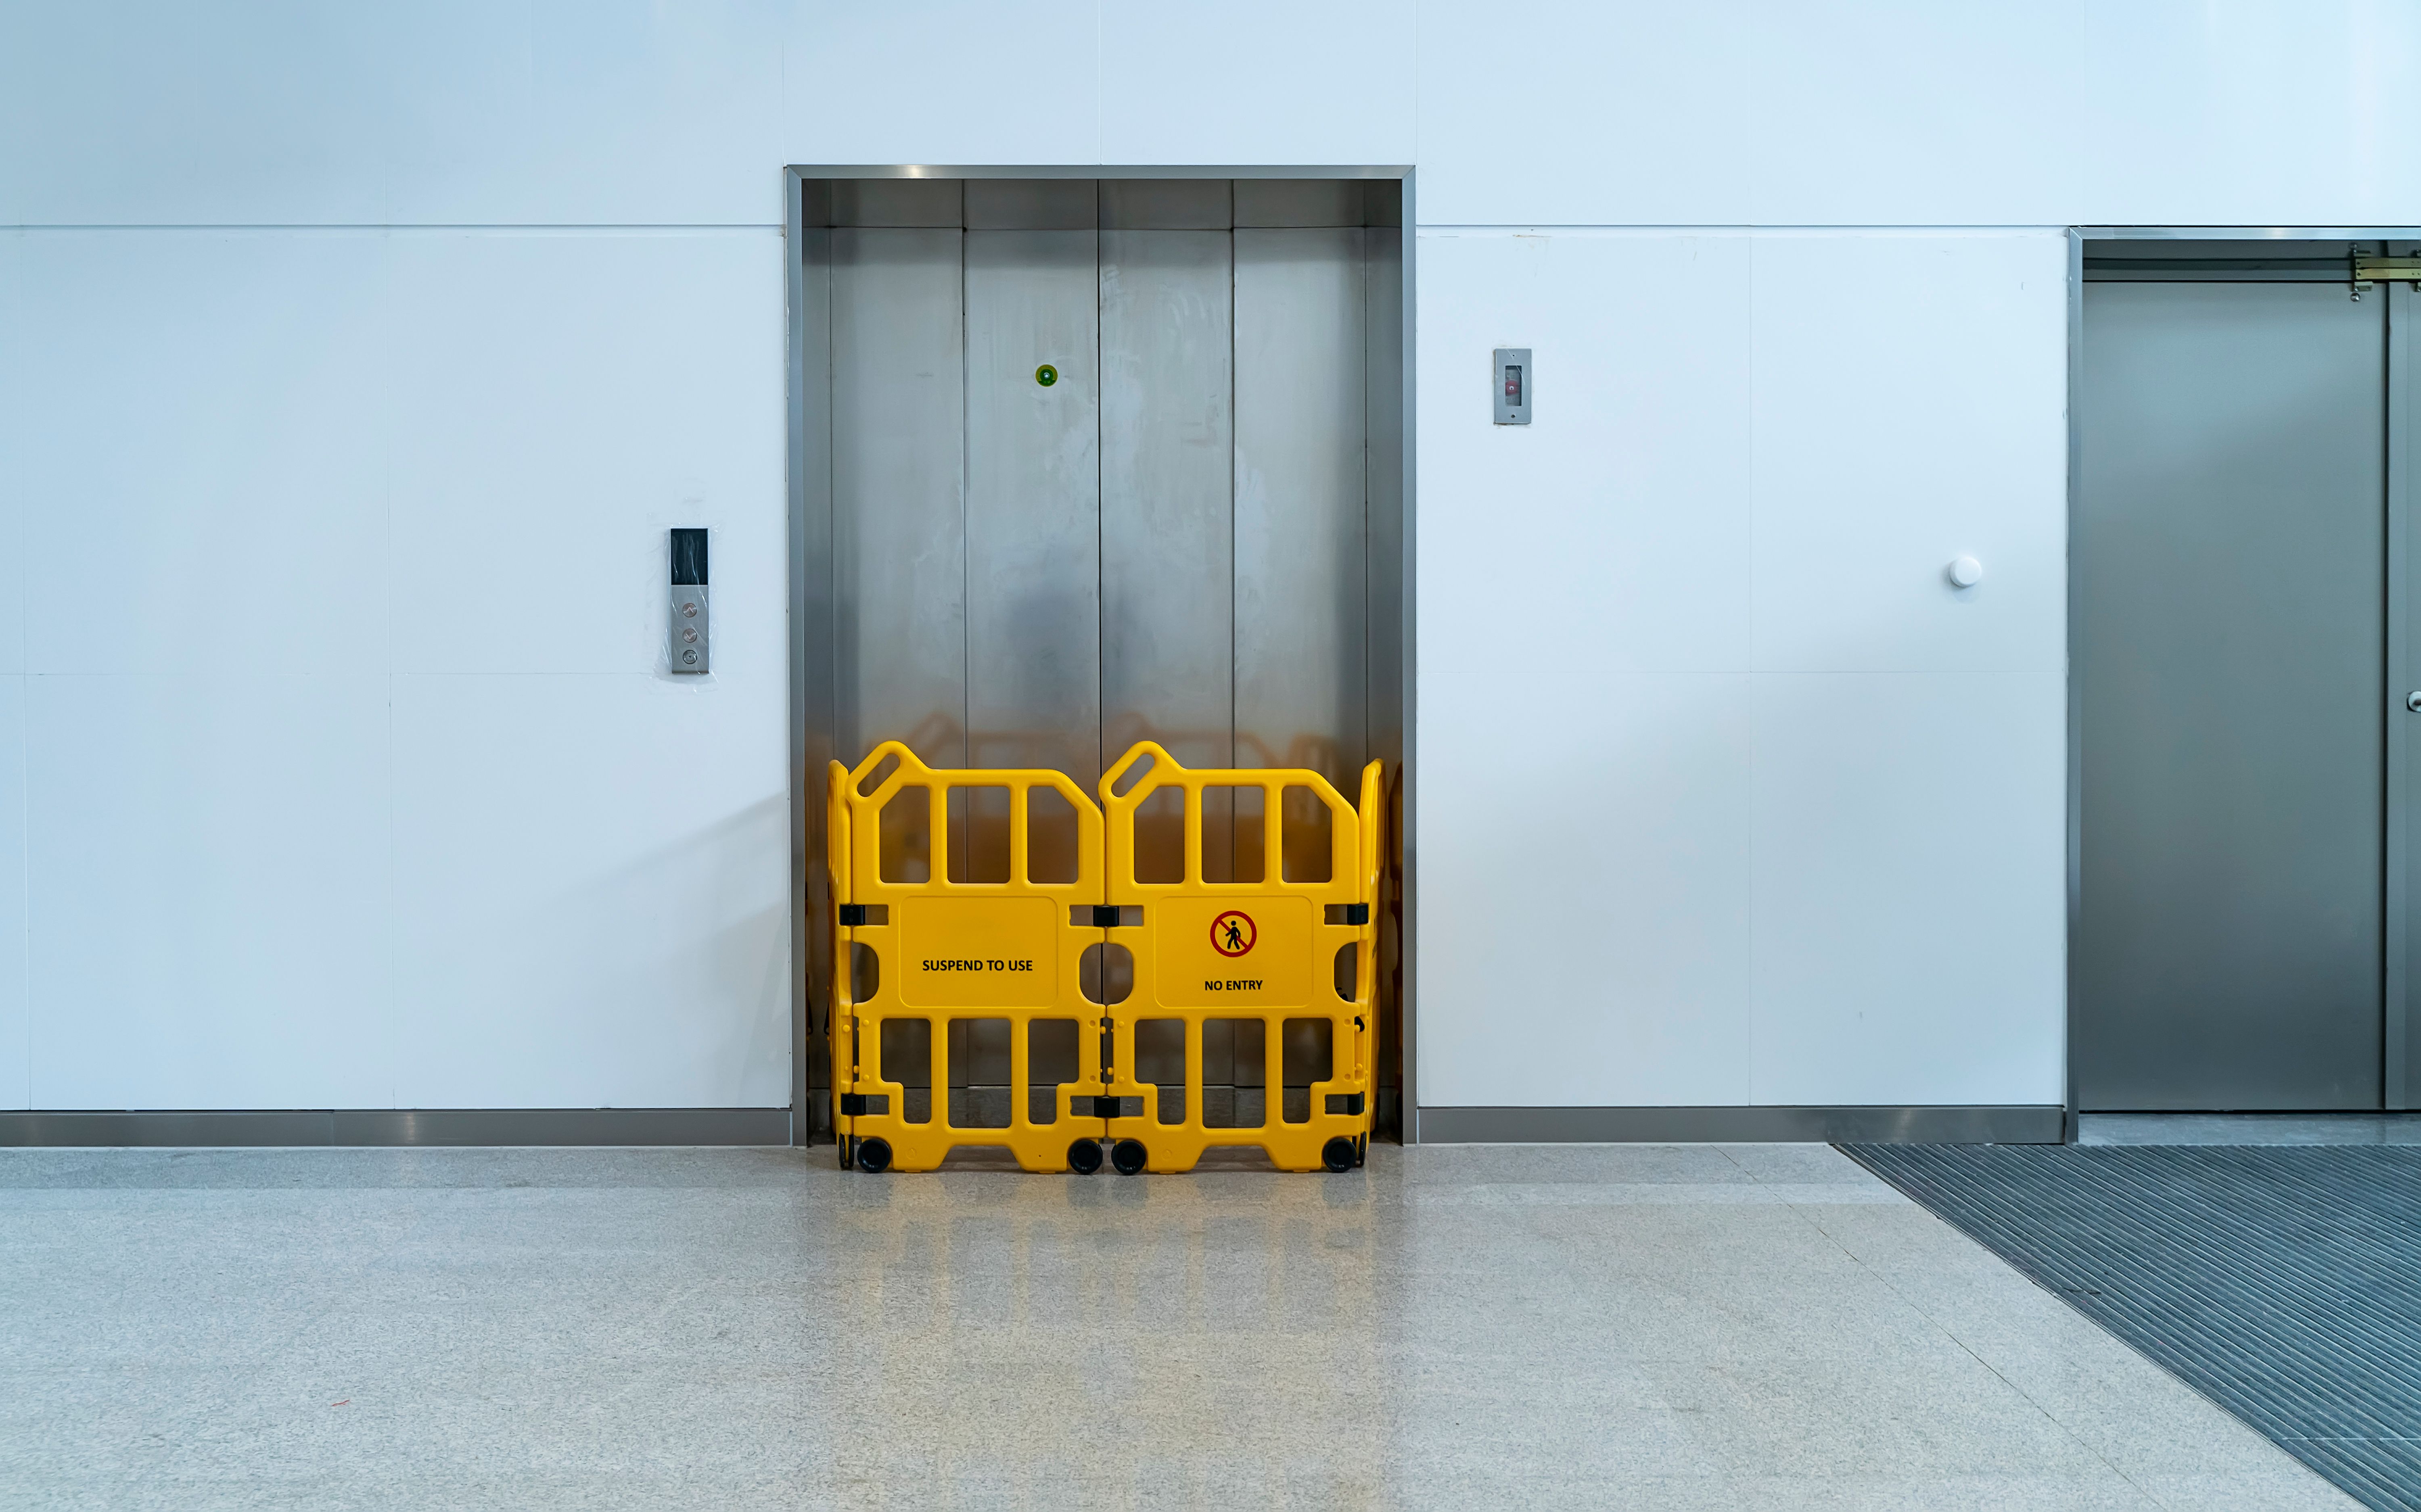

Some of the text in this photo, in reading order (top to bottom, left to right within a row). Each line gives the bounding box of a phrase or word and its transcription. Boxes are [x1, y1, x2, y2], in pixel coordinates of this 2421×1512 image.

[922, 960, 1033, 971] SUSPEND TO USE
[1205, 980, 1263, 990] NO ENTRY
